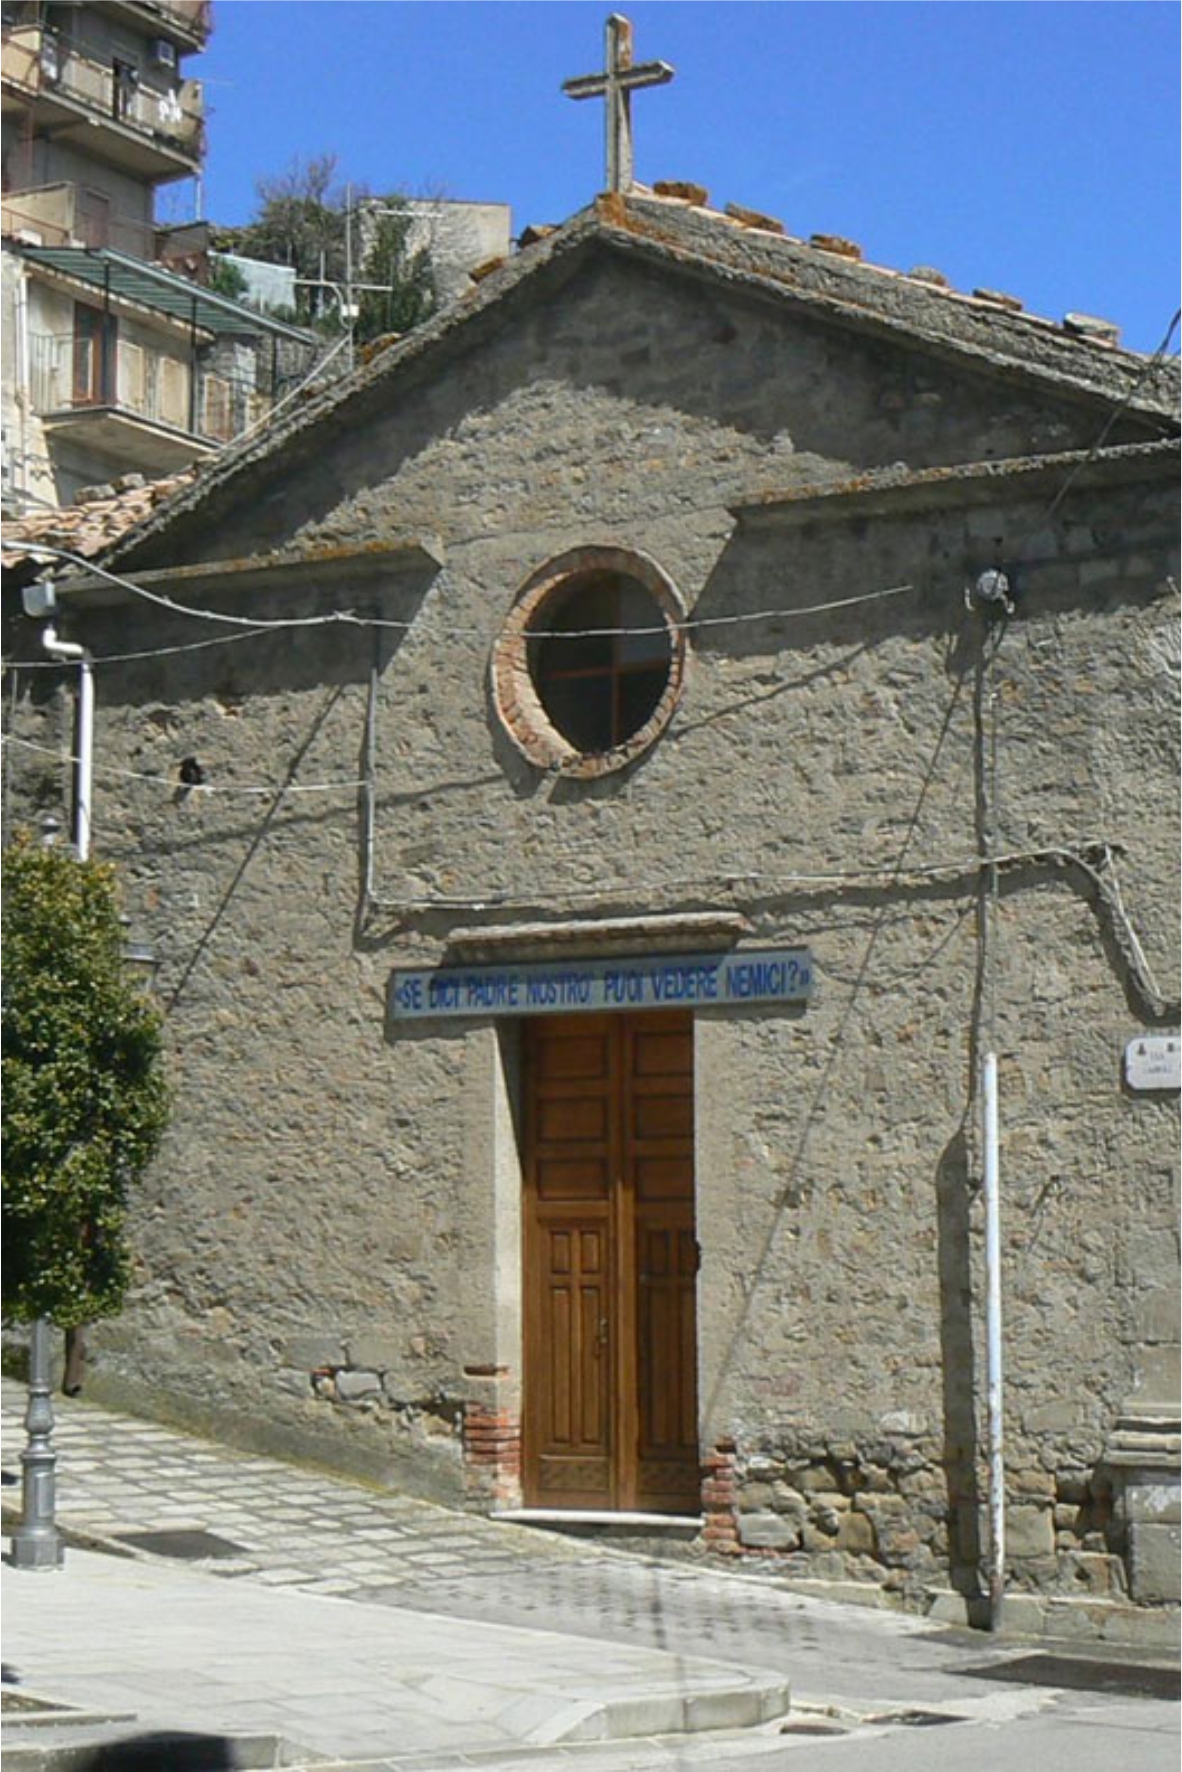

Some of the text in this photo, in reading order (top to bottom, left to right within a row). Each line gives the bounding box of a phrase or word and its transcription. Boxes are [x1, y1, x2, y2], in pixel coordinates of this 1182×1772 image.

[429, 977, 461, 1009] DICI
[604, 968, 644, 1002] PUOI
[652, 965, 718, 1000] VEDERE
